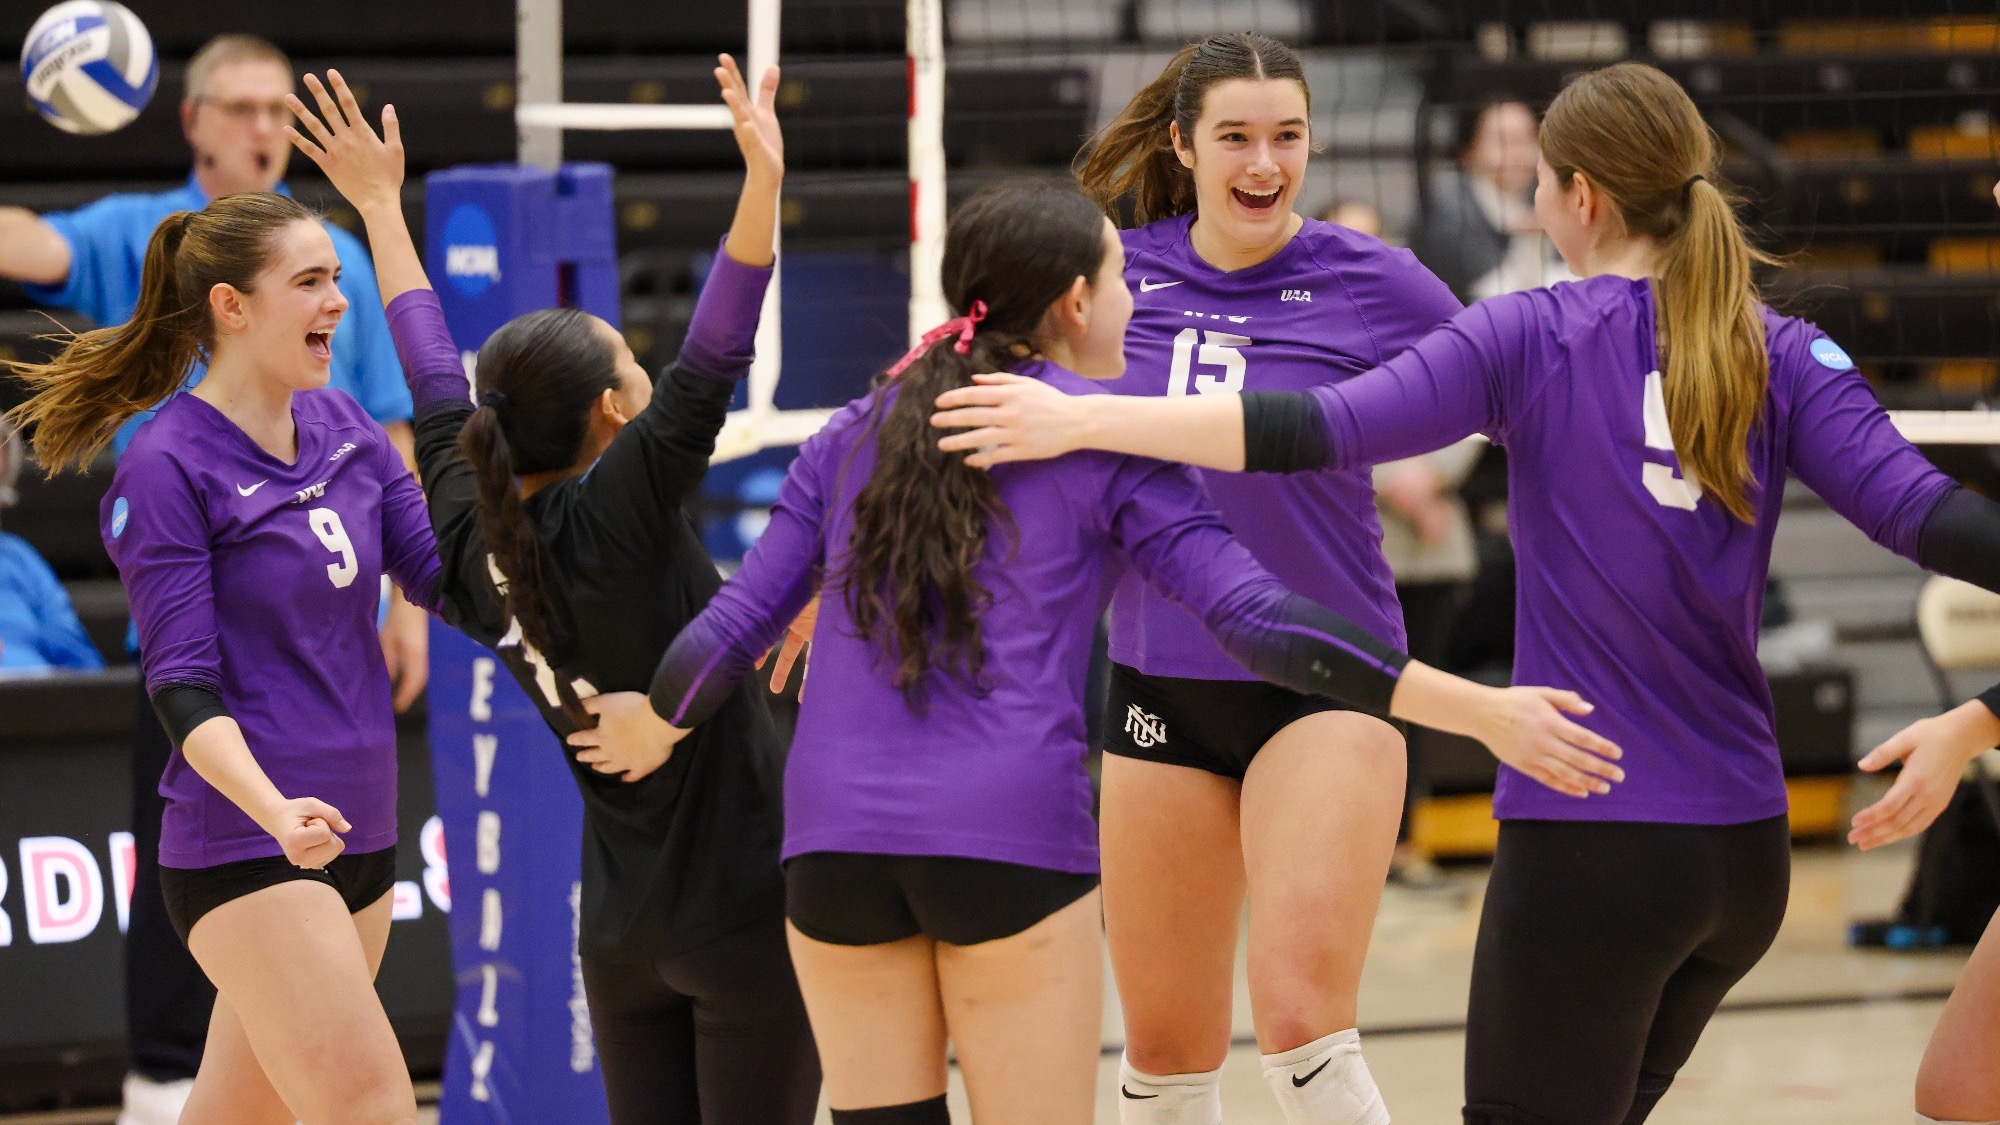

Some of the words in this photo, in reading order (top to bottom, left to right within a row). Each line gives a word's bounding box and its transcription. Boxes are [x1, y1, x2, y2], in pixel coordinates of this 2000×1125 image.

[1280, 289, 1312, 302] UAA
[1167, 327, 1253, 397] 15
[329, 442, 357, 461] UAA
[308, 507, 359, 589] 9
